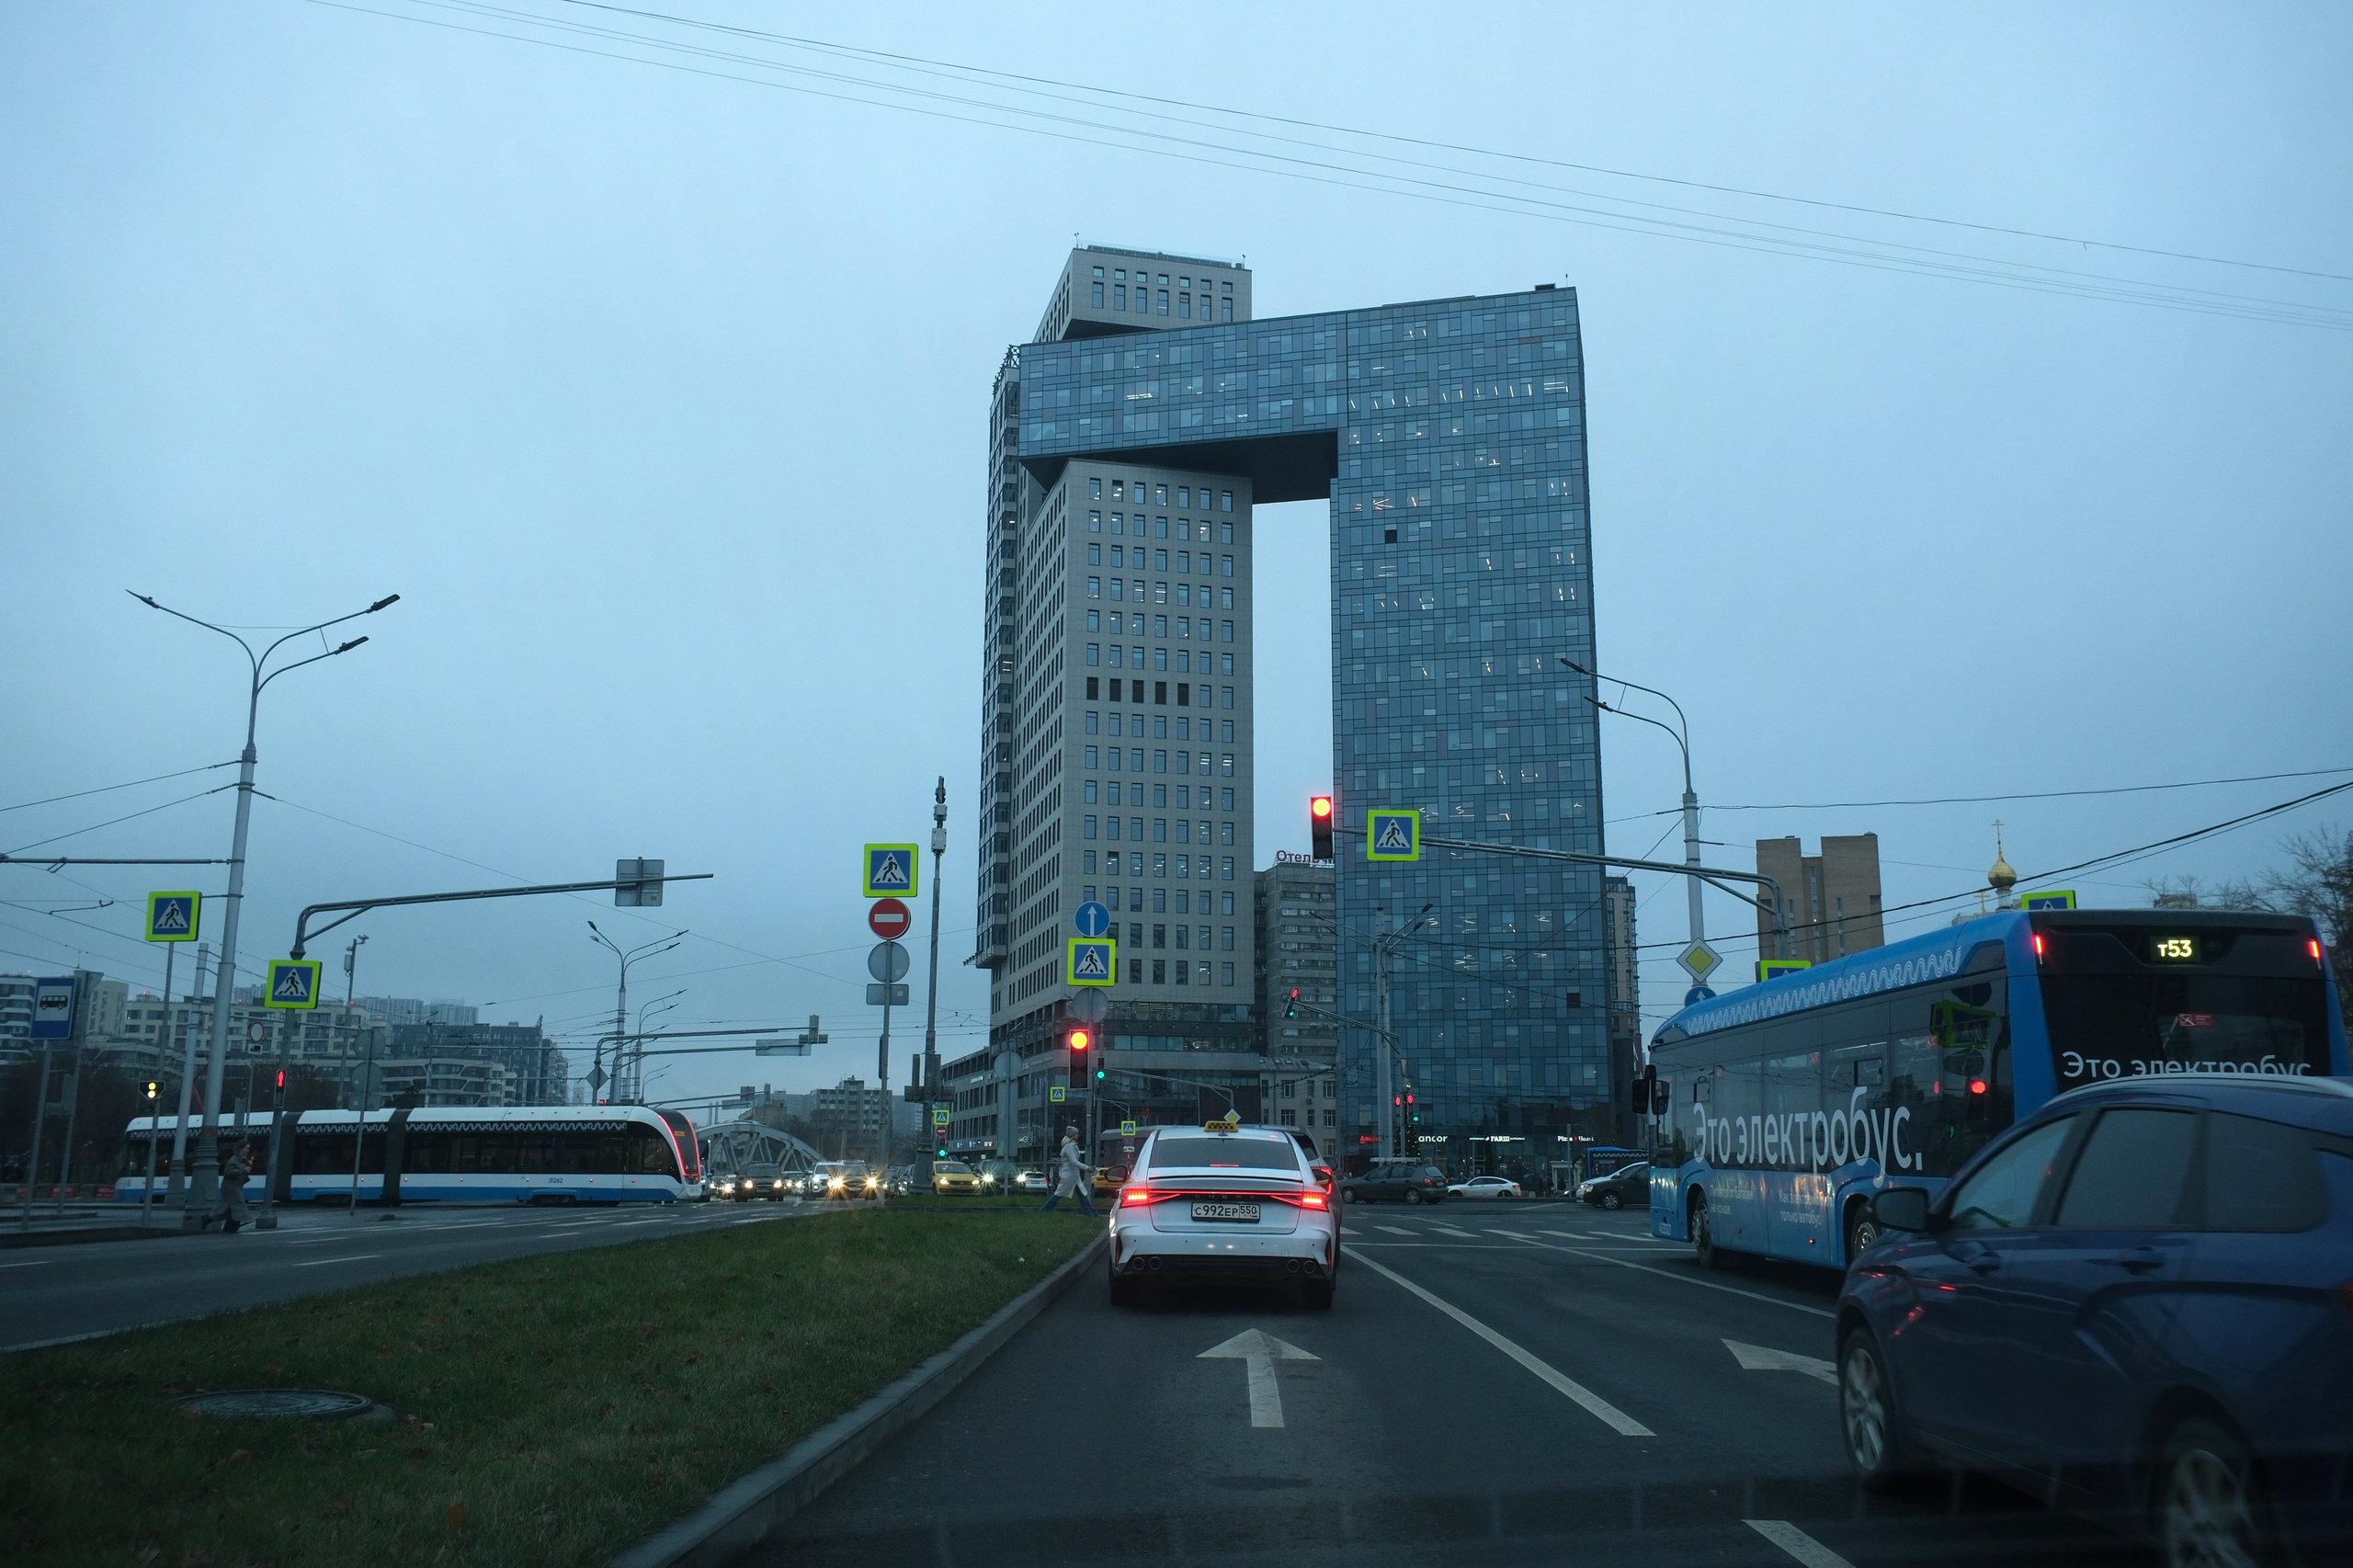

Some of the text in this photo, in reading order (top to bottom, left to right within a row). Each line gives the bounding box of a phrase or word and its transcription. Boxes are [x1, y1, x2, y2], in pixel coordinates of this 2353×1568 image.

[2062, 1051, 2121, 1079] Это
[1693, 1085, 1923, 1188] Это электробус.
